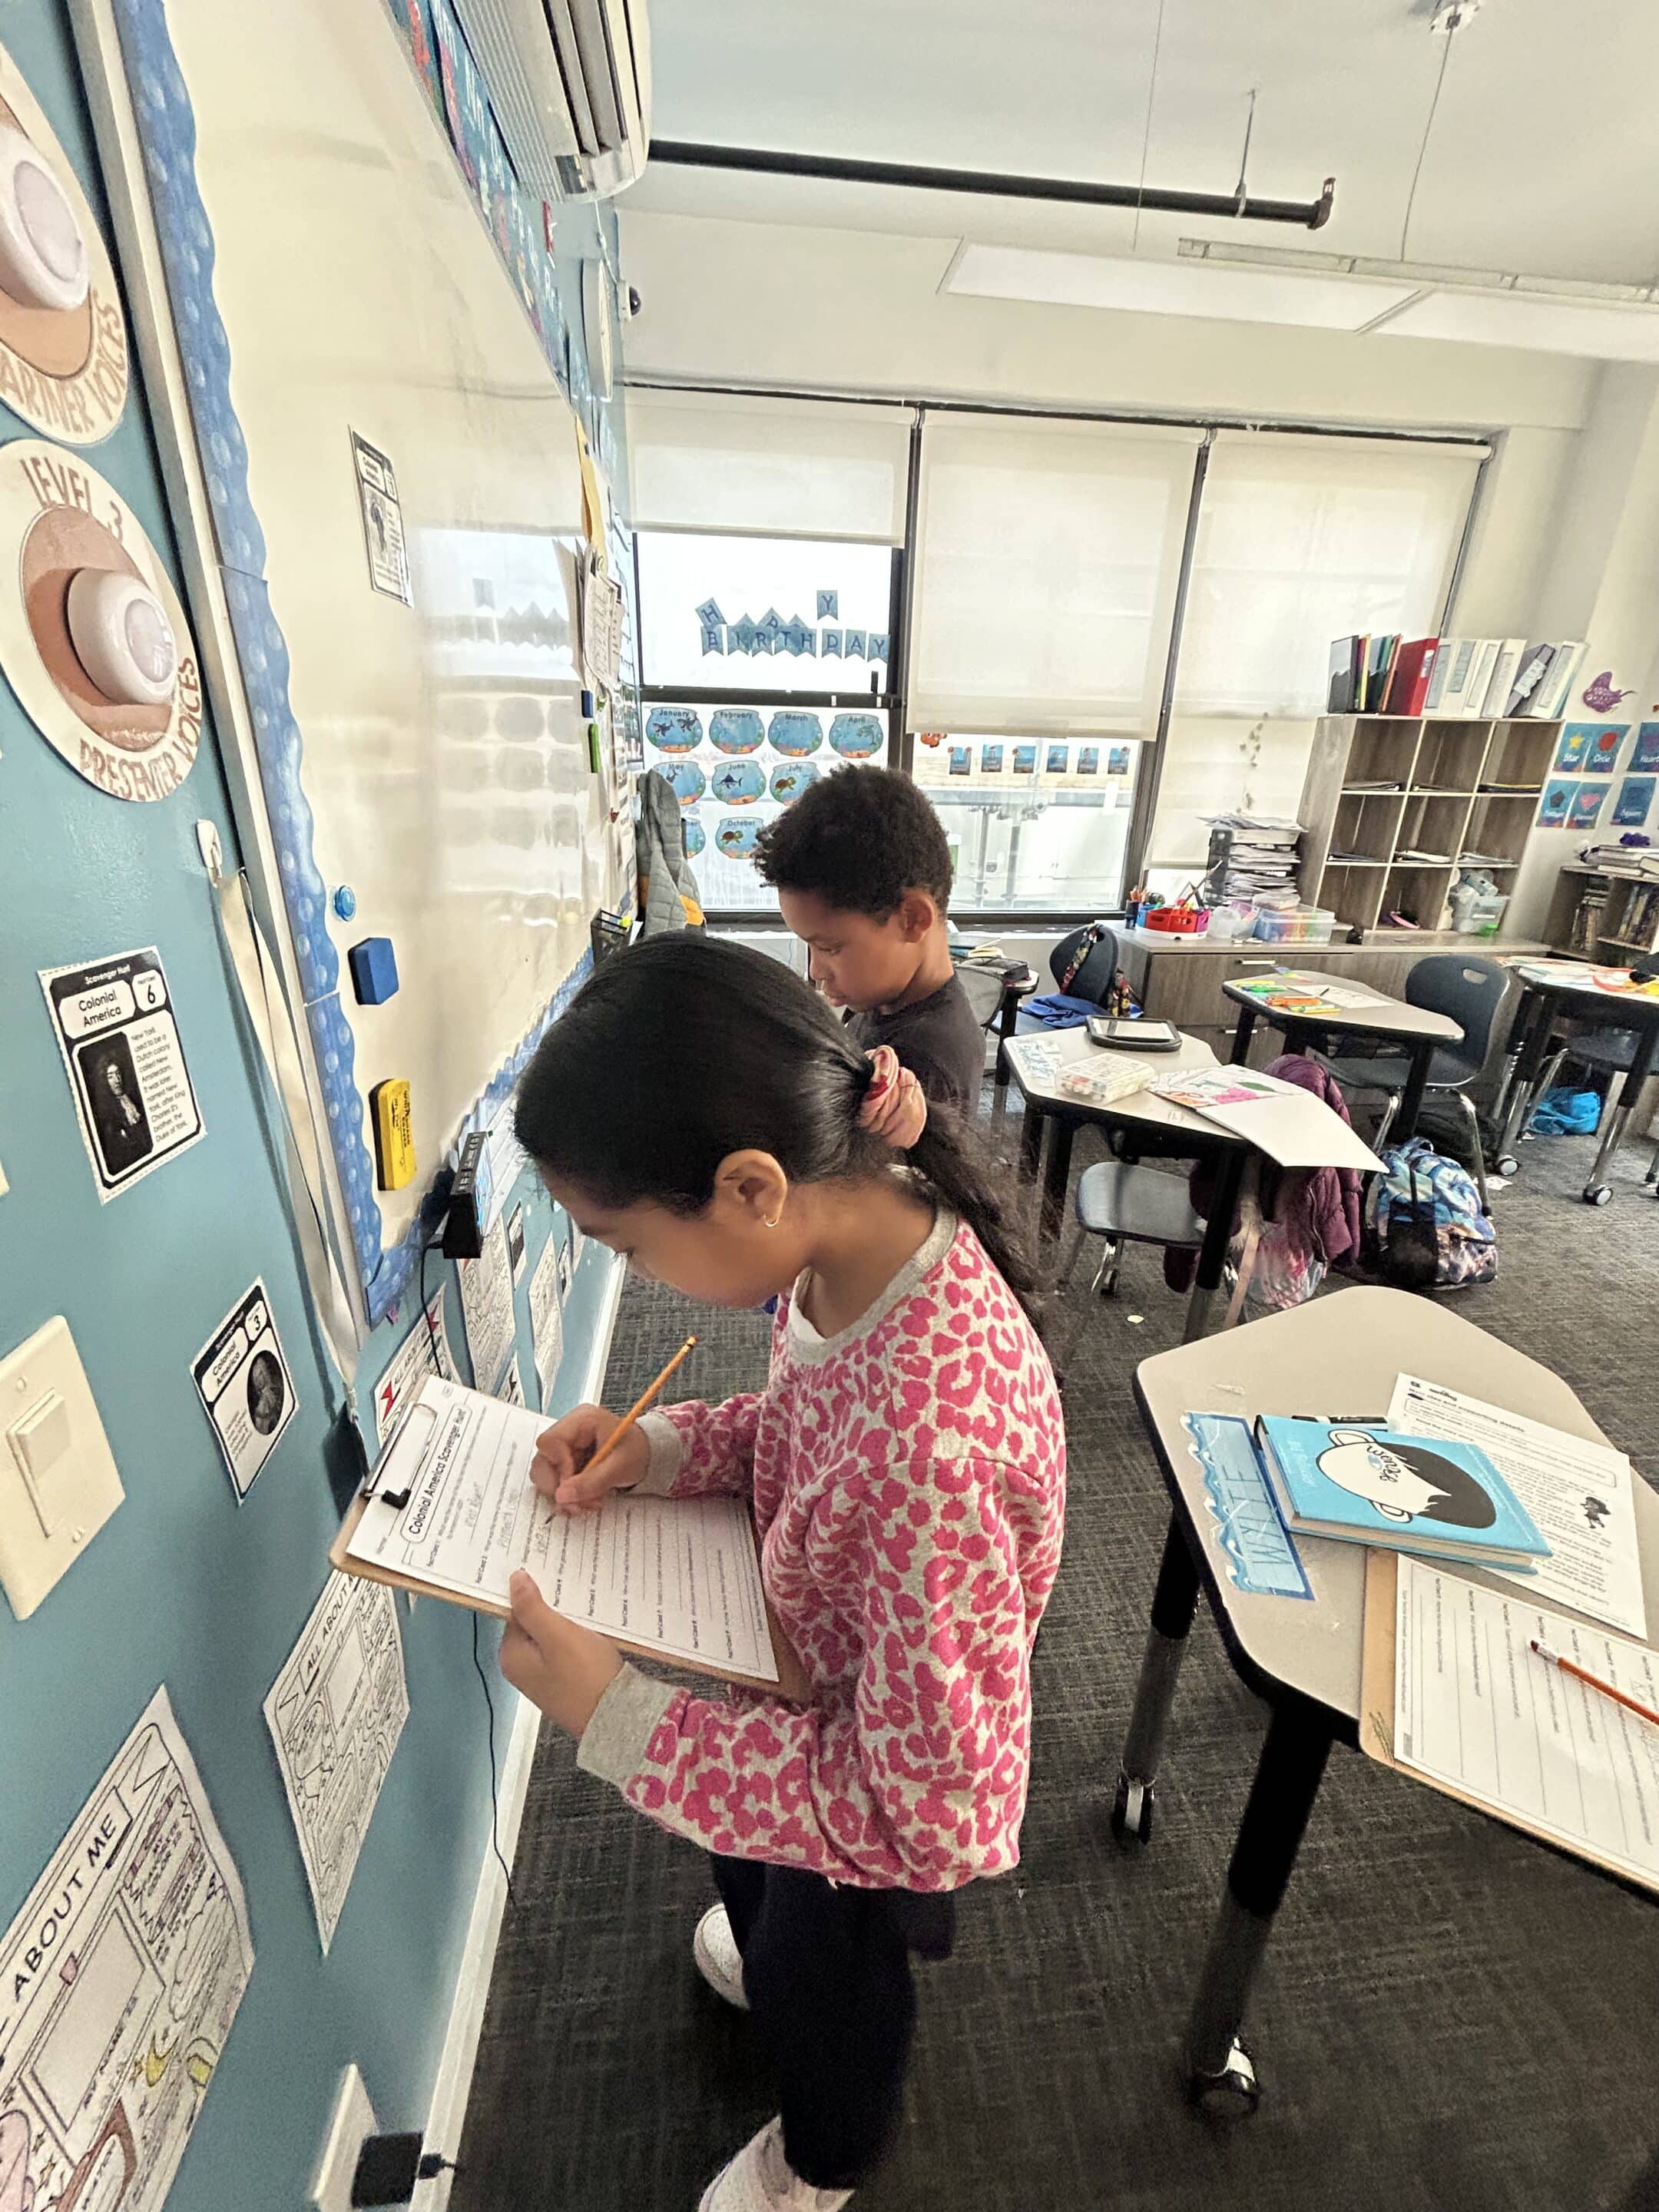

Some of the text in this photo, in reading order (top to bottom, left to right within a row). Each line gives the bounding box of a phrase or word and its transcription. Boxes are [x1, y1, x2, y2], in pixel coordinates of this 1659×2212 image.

[0, 289, 129, 432] ARTNER VOICES
[21, 456, 124, 544] LEVEL 3
[707, 630, 884, 653] BIRTHDAY
[657, 708, 690, 719] January
[720, 710, 753, 720] February
[785, 713, 808, 722] March
[848, 715, 866, 724] April
[80, 656, 202, 803] PRESENTER VOICES
[787, 764, 802, 773] July
[1563, 753, 1579, 763] Star
[727, 819, 757, 827] October
[84, 969, 117, 985] Scavenger
[78, 989, 117, 1012] Colonial
[147, 984, 155, 1004] 6
[83, 1005, 121, 1028] America
[253, 1315, 261, 1331] 3
[212, 1340, 237, 1377] Colonial
[216, 1351, 240, 1387] America
[408, 1495, 432, 1535] Colonial
[422, 1459, 446, 1497] America
[435, 1422, 462, 1462] Scavenger
[308, 1645, 320, 1674] ALL
[323, 1584, 347, 1640] ABOUT
[13, 1813, 115, 2002] ABOUT ME
